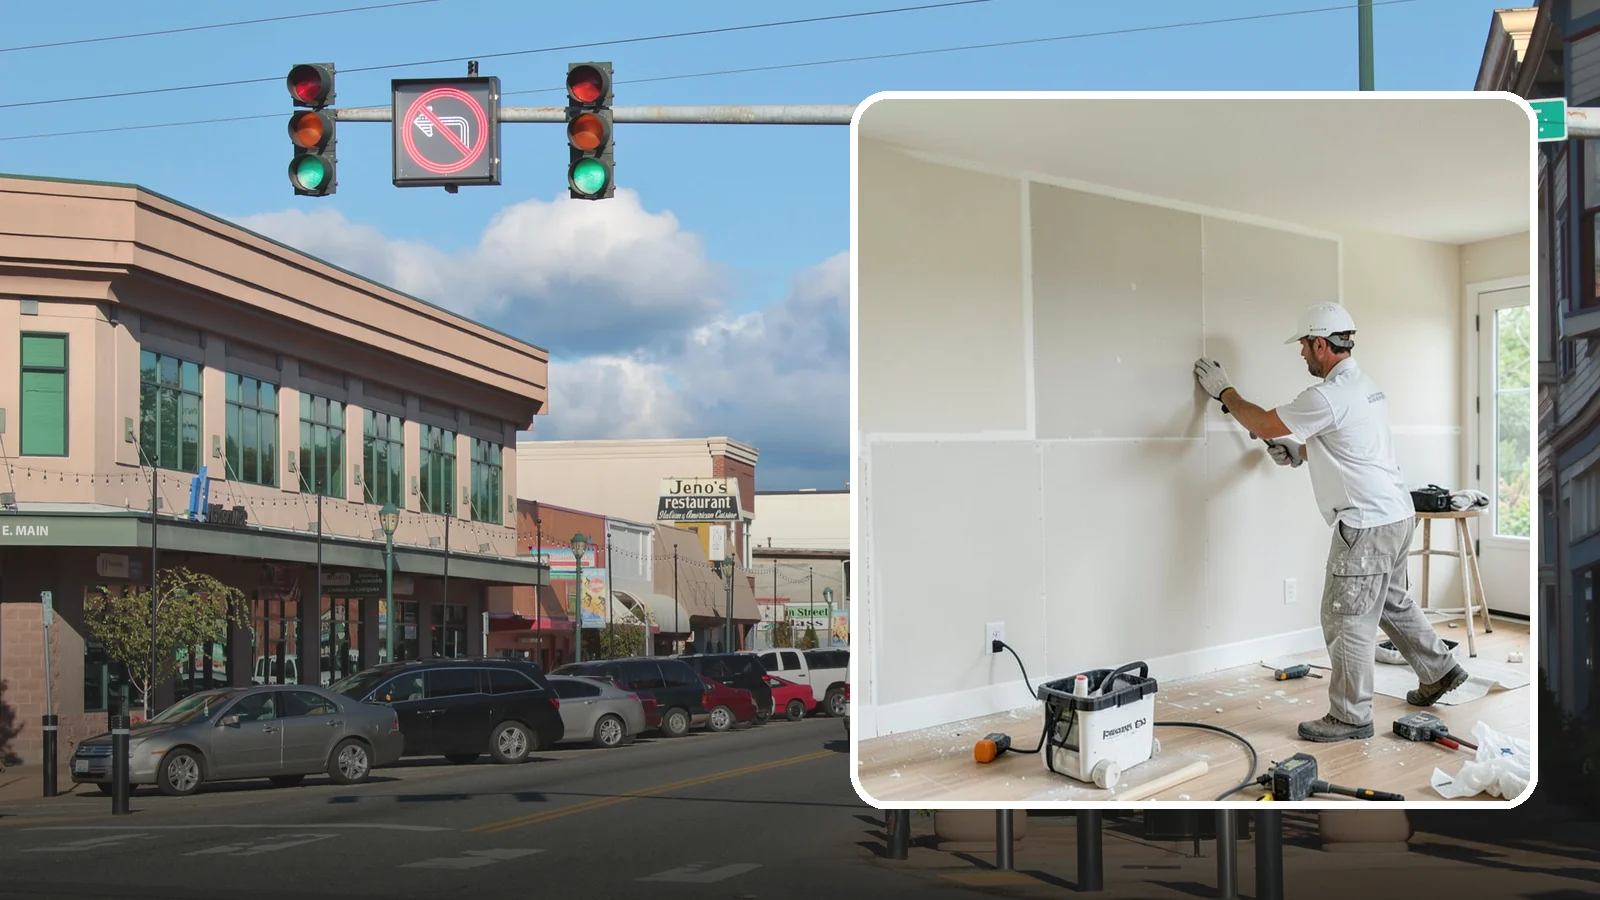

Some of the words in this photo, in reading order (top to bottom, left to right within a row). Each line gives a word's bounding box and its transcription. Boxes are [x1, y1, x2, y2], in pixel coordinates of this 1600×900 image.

[669, 480, 727, 494] Jeno's
[665, 496, 731, 509] restaurant
[686, 509, 714, 519] American
[715, 509, 738, 519] Cuisine
[2, 525, 13, 536] E.
[15, 525, 49, 536] MAIN
[797, 607, 829, 617] Street
[790, 619, 824, 627] lass
